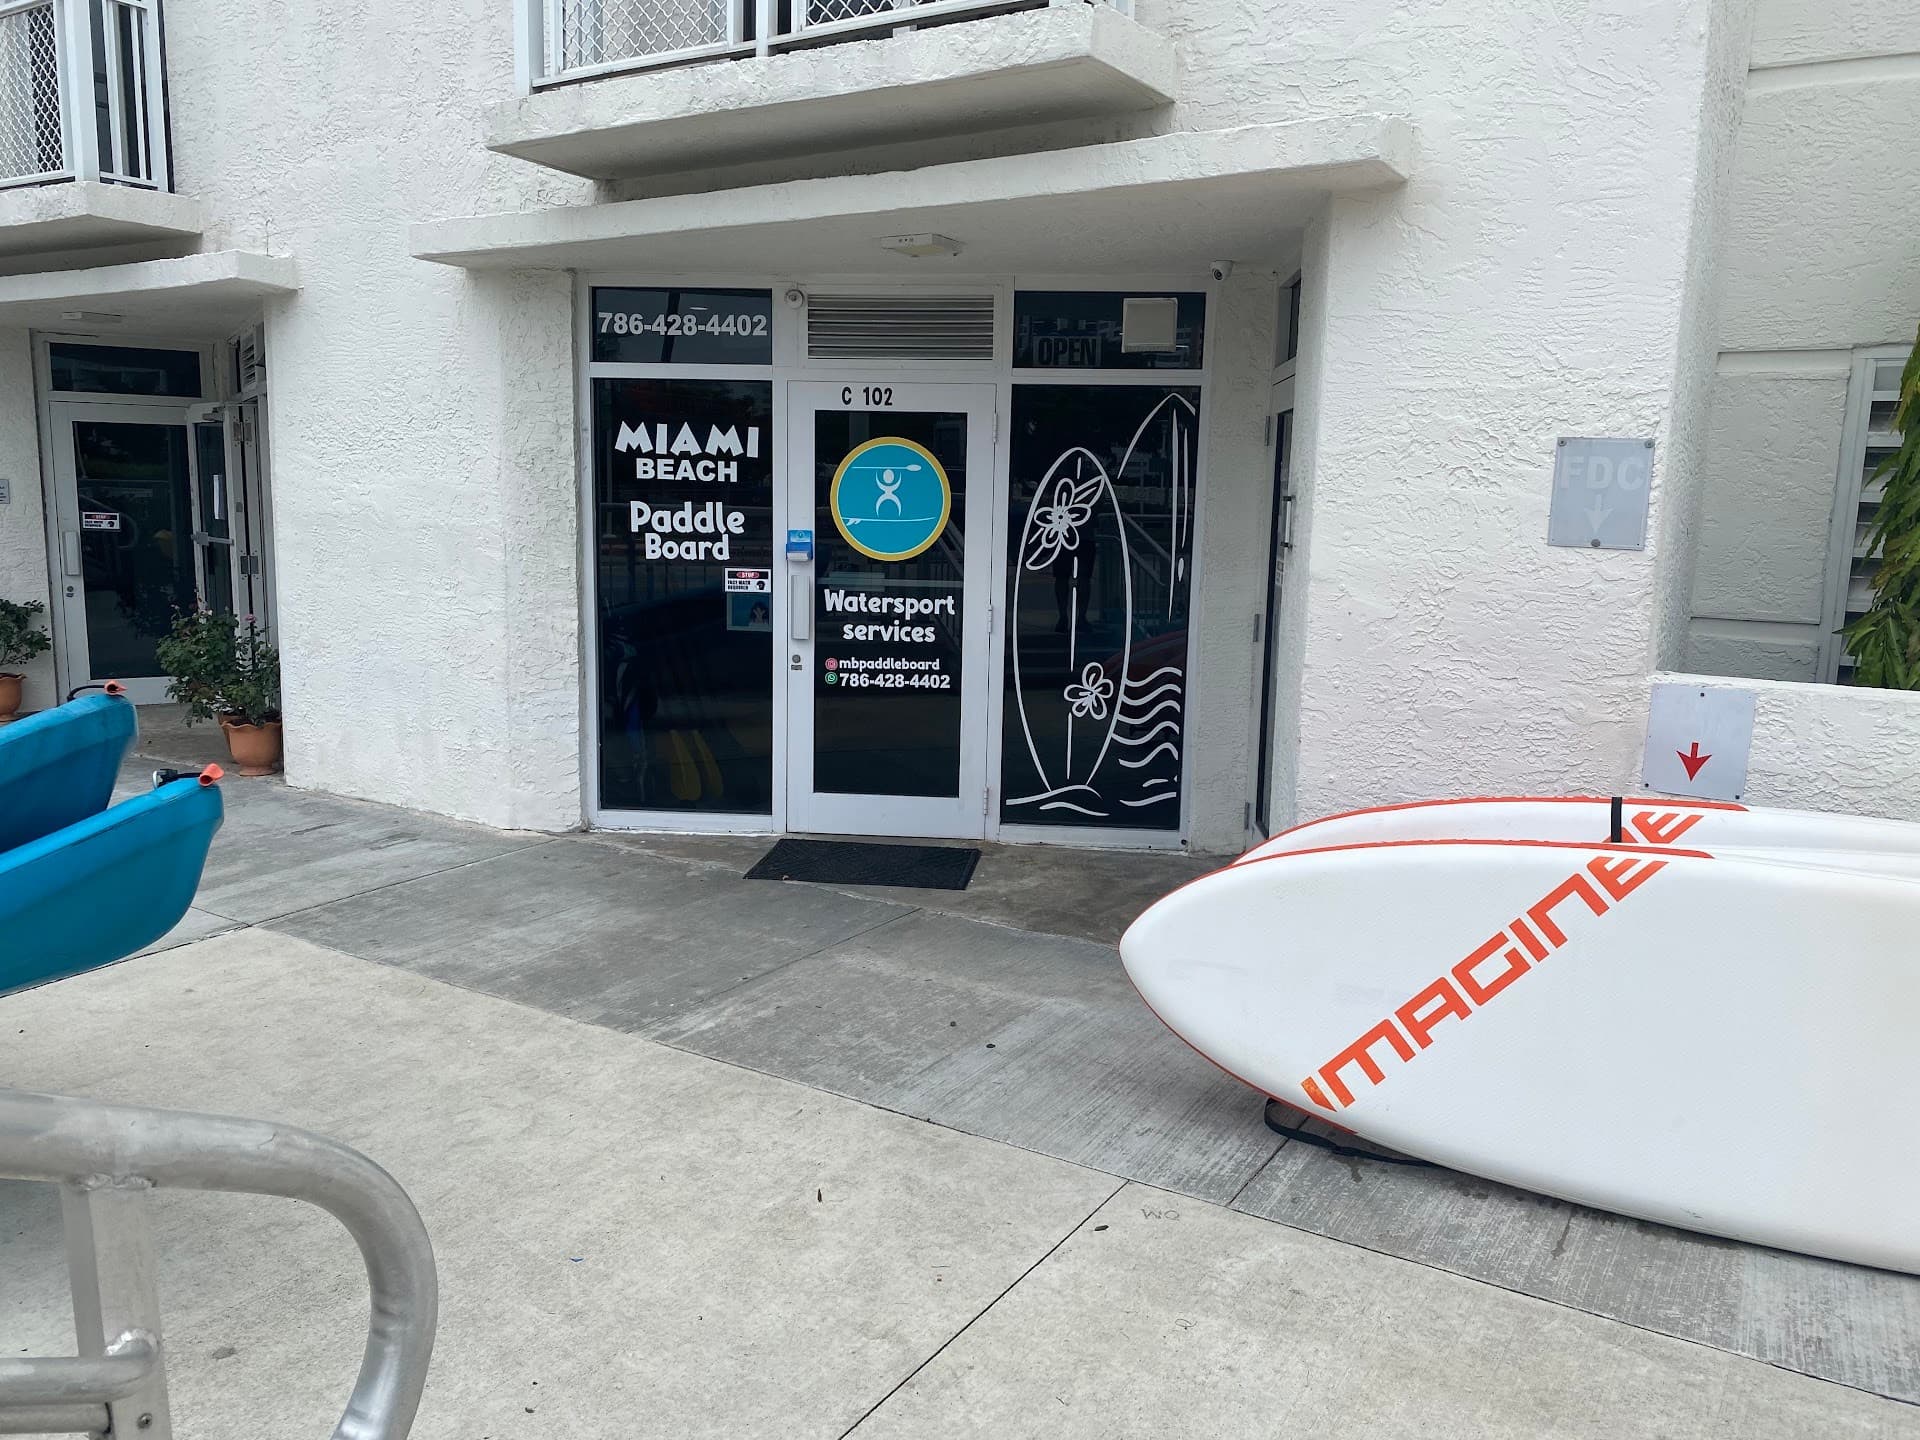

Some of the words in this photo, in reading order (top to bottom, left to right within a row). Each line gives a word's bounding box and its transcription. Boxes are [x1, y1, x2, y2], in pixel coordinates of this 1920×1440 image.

[598, 312, 768, 337] 786-428-4402
[1038, 337, 1096, 366] OPEN
[841, 387, 852, 406] C
[863, 387, 893, 406] 102
[615, 421, 760, 458] MIAMI
[636, 459, 738, 483] BEACH
[1560, 456, 1644, 490] FDC
[630, 501, 745, 536] Paddle
[644, 534, 730, 561] Board
[824, 589, 956, 621] Watersport
[843, 620, 935, 642] services
[839, 657, 940, 672] mbpaddleboard
[839, 673, 951, 688] 786-428-4402
[1301, 856, 1669, 1112] IMAGINE
